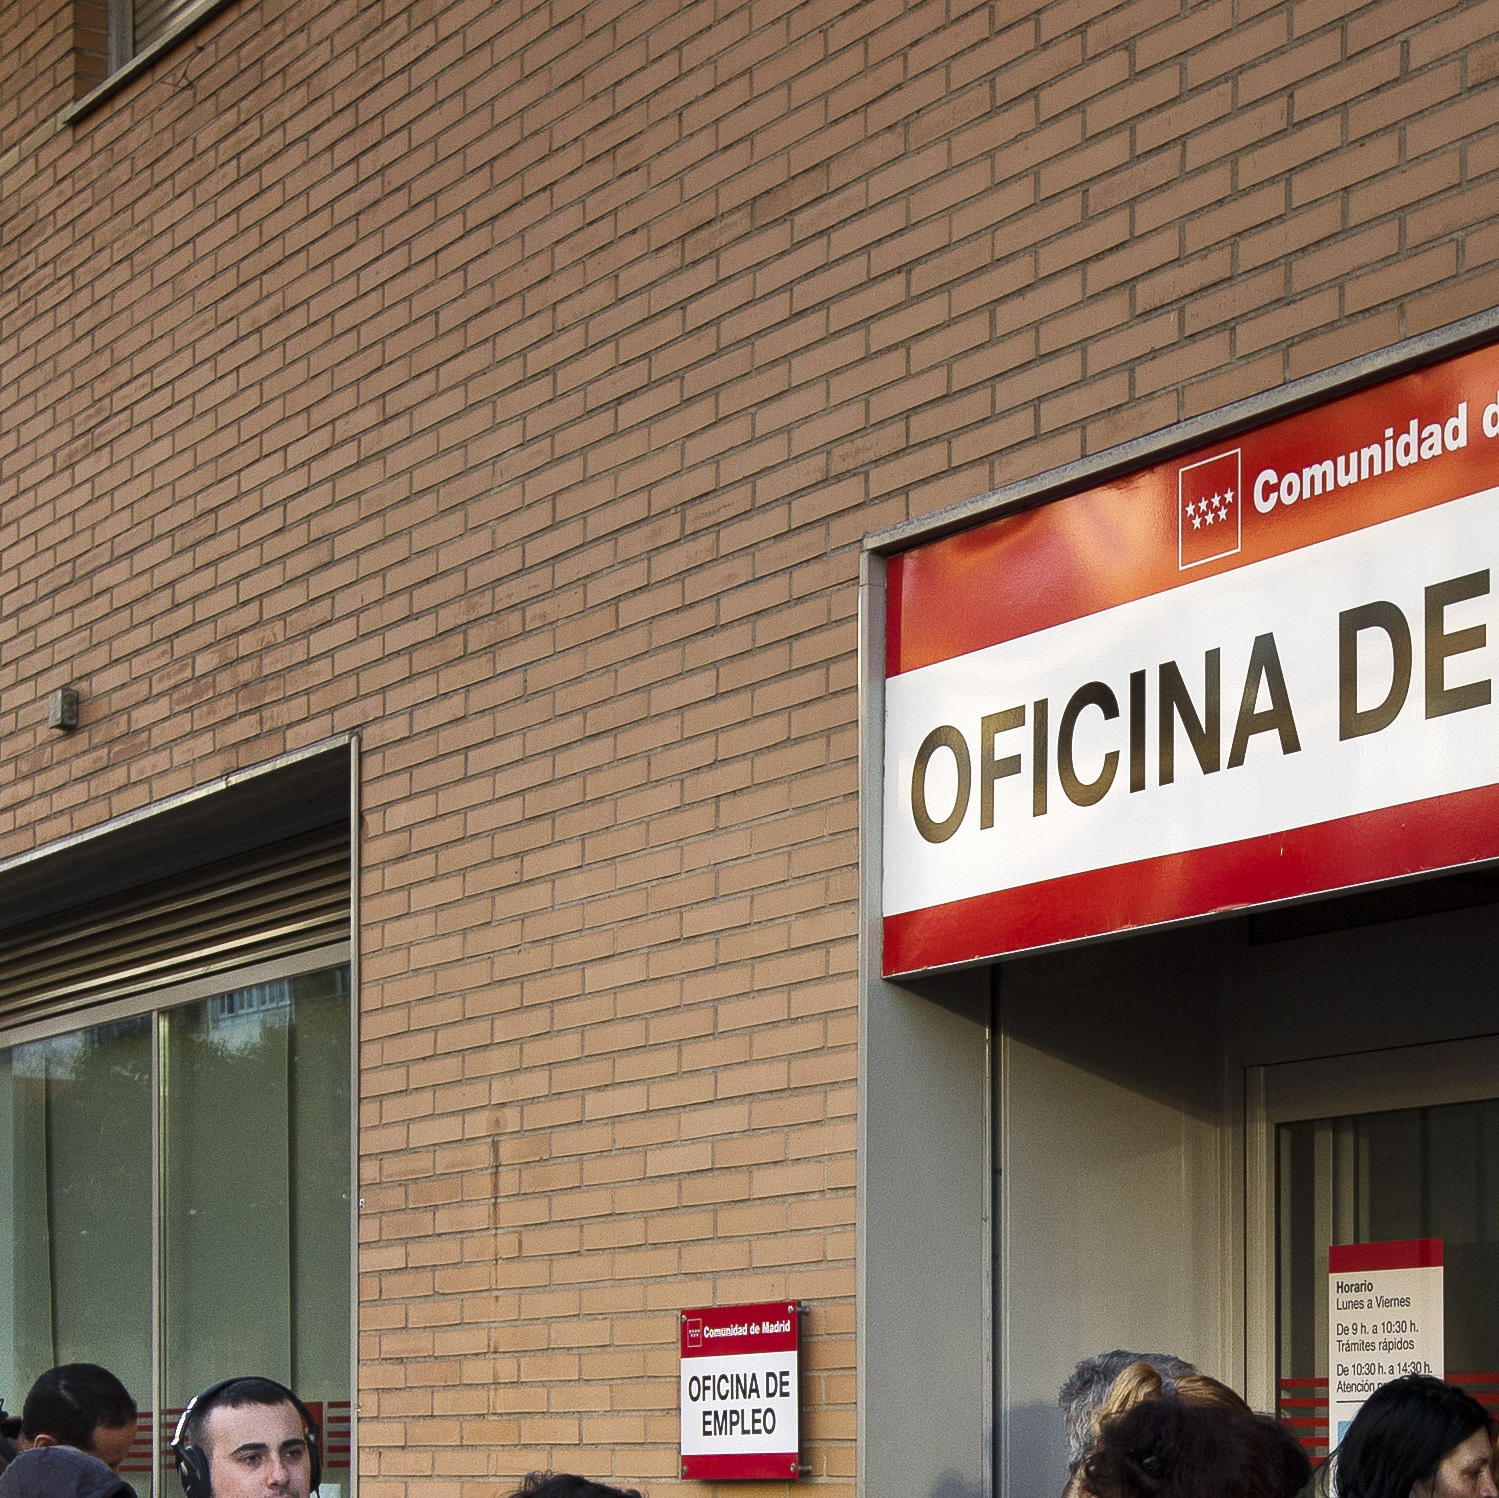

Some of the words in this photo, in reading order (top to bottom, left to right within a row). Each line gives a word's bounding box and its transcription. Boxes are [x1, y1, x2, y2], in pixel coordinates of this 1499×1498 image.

[1253, 402, 1469, 514] Comunidad
[909, 632, 1303, 845] OFICINA
[1337, 568, 1493, 742] DE
[1336, 1280, 1374, 1294] Horario
[1336, 1297, 1365, 1311] Lunes
[1366, 1299, 1373, 1309] a
[1375, 1295, 1411, 1308] Viernes
[703, 1323, 748, 1339] Comunidad
[749, 1322, 761, 1335] de
[762, 1319, 791, 1335] Madrid
[1336, 1323, 1350, 1336] De
[1351, 1322, 1358, 1335] 9
[1360, 1322, 1370, 1335] h.
[1372, 1324, 1378, 1334] a
[1381, 1320, 1408, 1334] 10:30
[1409, 1320, 1419, 1333] h.
[1336, 1339, 1376, 1353] Trámites
[1378, 1337, 1415, 1353] rápidos
[1336, 1363, 1350, 1376] De
[1351, 1362, 1376, 1376] 10:30
[1377, 1362, 1387, 1375] h.
[1388, 1364, 1395, 1375] a
[1397, 1360, 1422, 1375] 14:30
[1423, 1360, 1433, 1374] h.
[688, 1371, 761, 1402] OFICINA
[765, 1370, 790, 1399] DE
[1336, 1379, 1376, 1393] Atención
[702, 1407, 776, 1437] EMPLEO
